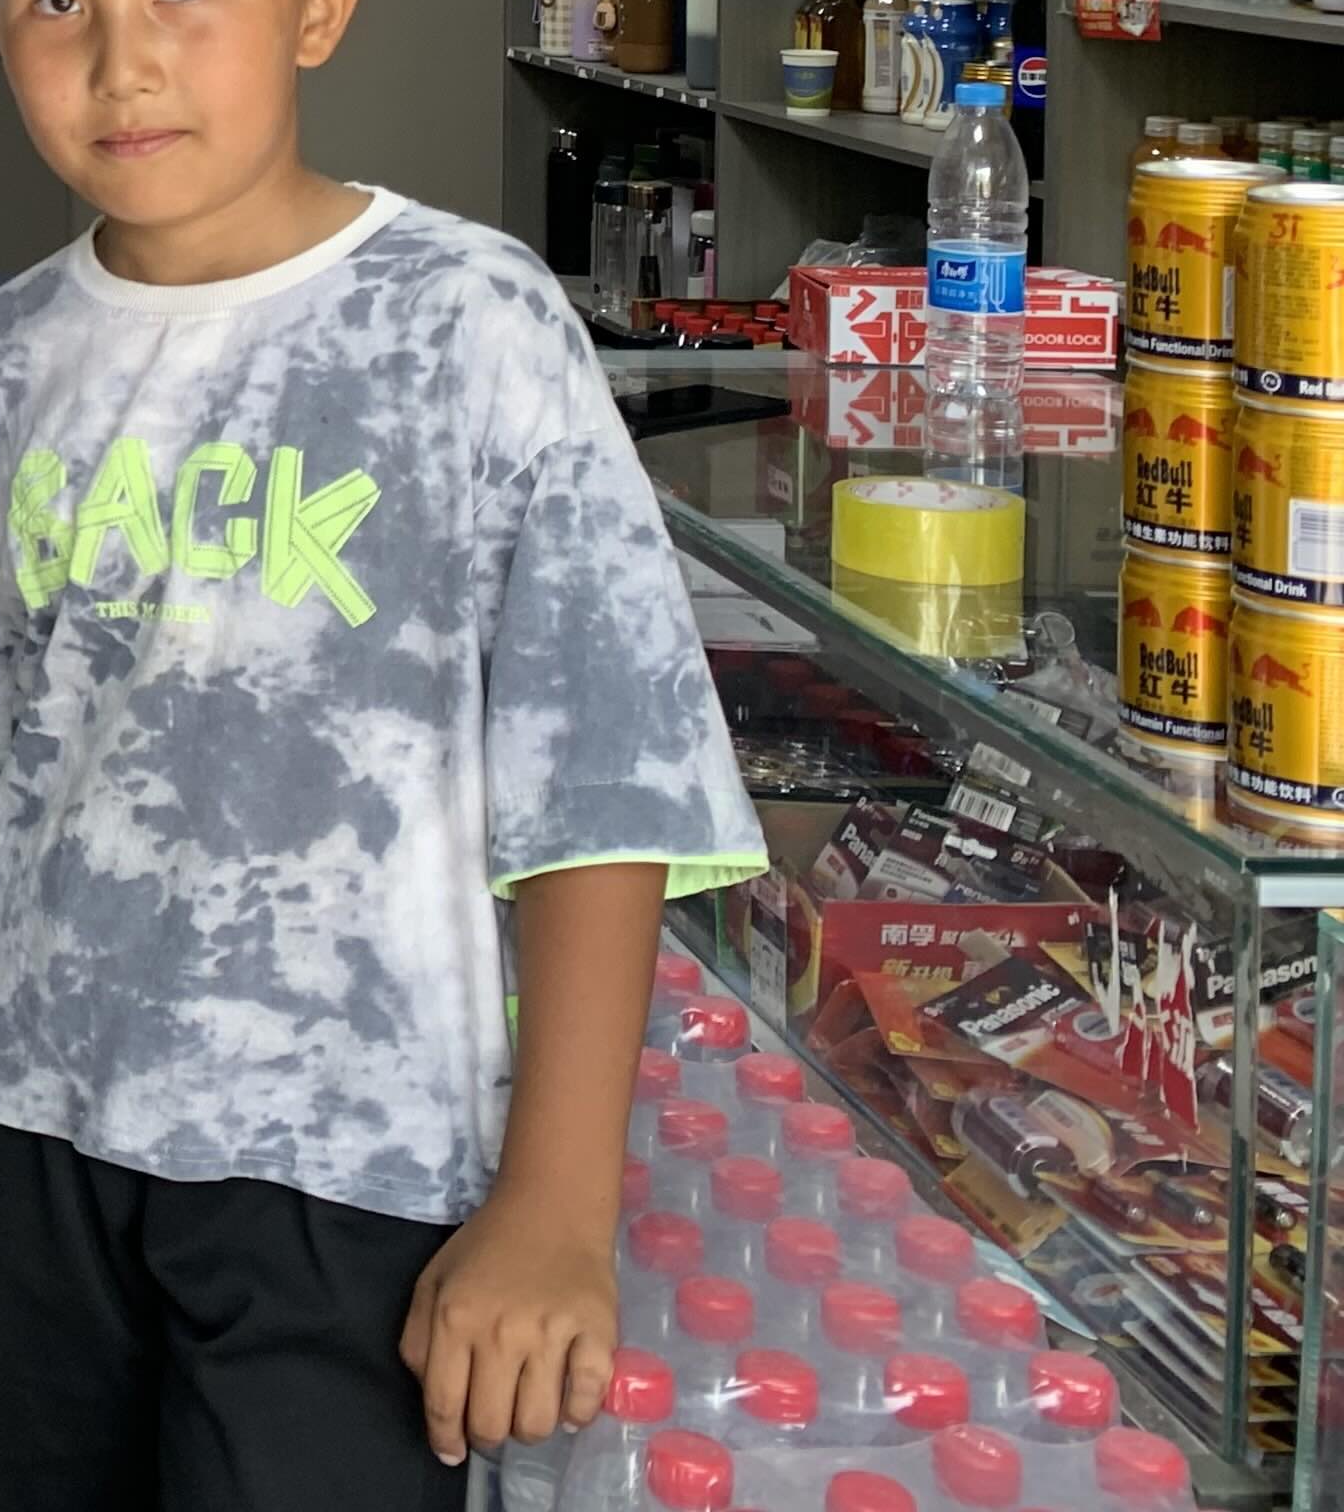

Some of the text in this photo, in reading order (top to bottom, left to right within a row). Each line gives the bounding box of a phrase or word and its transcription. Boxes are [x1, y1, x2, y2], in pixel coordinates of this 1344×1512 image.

[1132, 291, 1181, 322] 红牛
[1067, 334, 1102, 347] LOCK
[1150, 337, 1206, 357] Functional
[1136, 452, 1193, 488] RedBull
[1135, 482, 1193, 514] 红牛
[1274, 578, 1308, 598] Drink
[95, 600, 138, 619] THIS
[1139, 642, 1199, 680] RedBull
[1138, 672, 1198, 705] 红牛
[1165, 719, 1227, 742] Functional
[880, 923, 937, 946] 南孚
[957, 982, 1062, 1038] Panasonic
